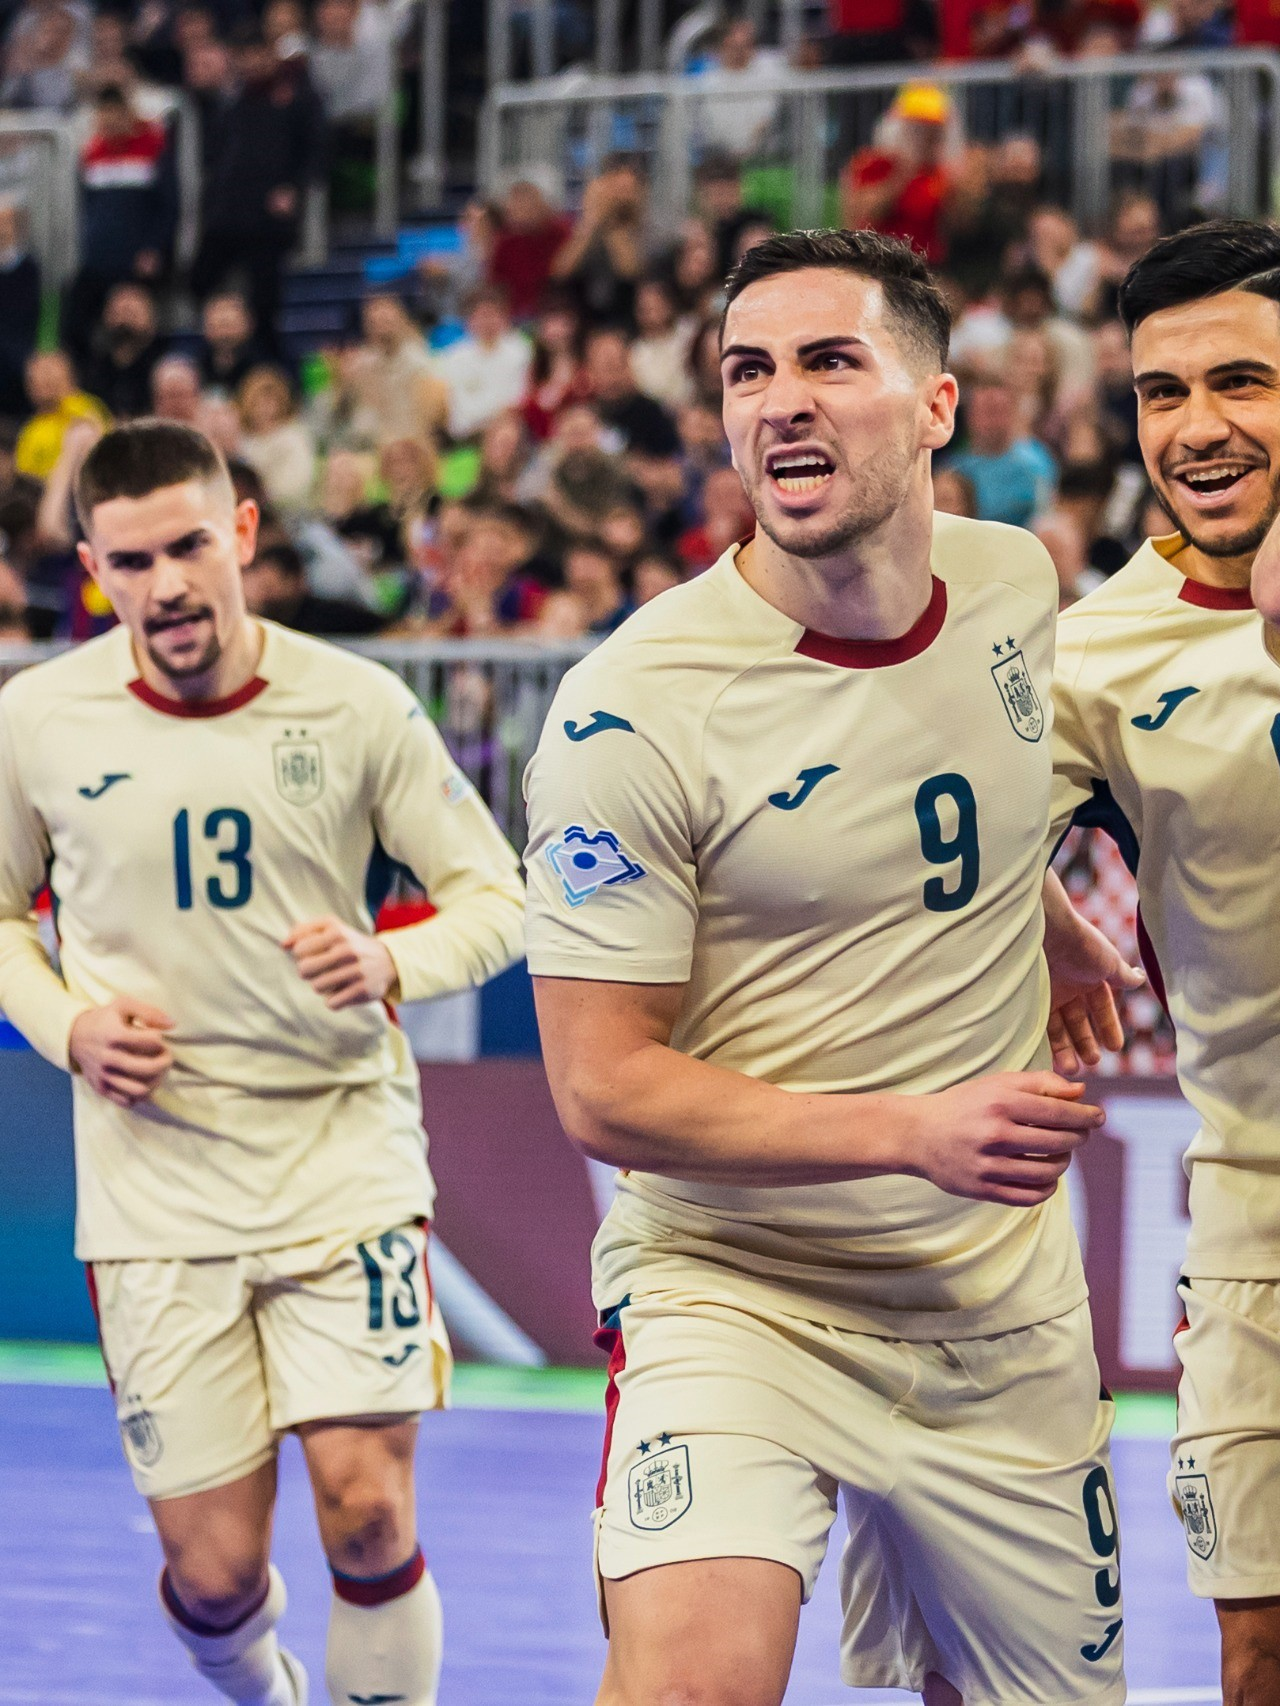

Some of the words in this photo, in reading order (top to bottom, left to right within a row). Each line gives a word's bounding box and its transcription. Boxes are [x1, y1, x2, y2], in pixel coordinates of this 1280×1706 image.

[173, 807, 253, 910] 13
[914, 772, 980, 912] 9
[356, 1231, 421, 1330] 13
[1082, 1465, 1121, 1608] 9
